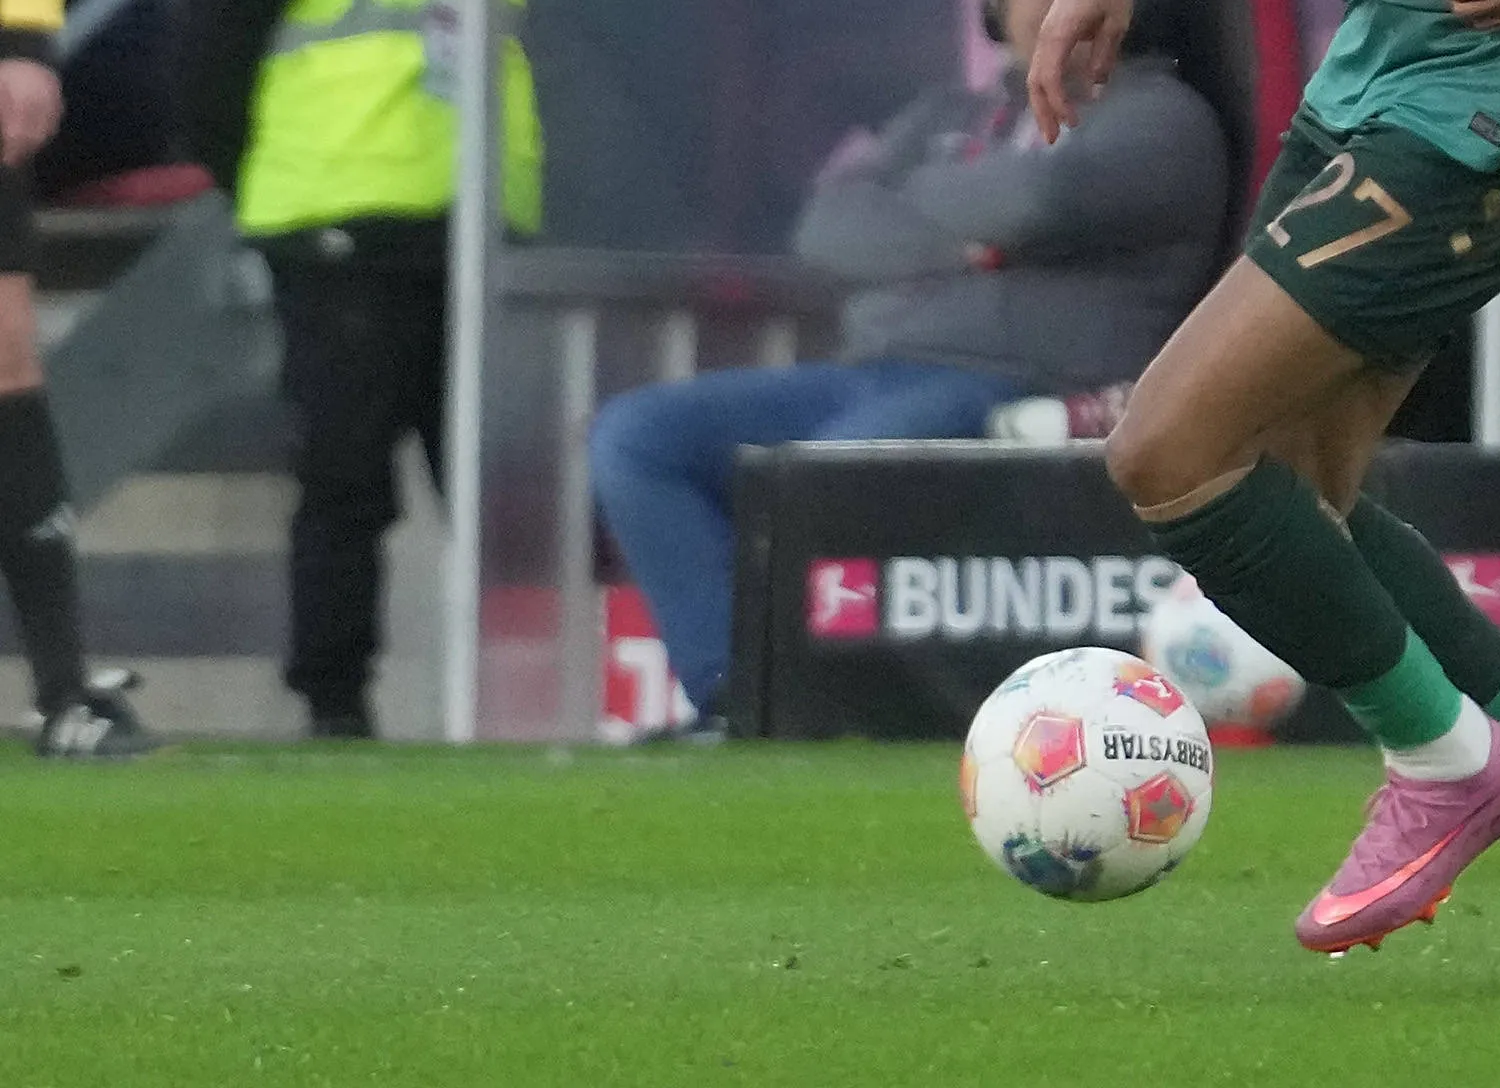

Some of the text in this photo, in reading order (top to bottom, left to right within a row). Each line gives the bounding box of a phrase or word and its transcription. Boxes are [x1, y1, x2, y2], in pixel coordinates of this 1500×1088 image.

[1266, 152, 1414, 269] 27
[886, 555, 1180, 637] BUNDES
[1103, 733, 1210, 774] DERBYSTAR
